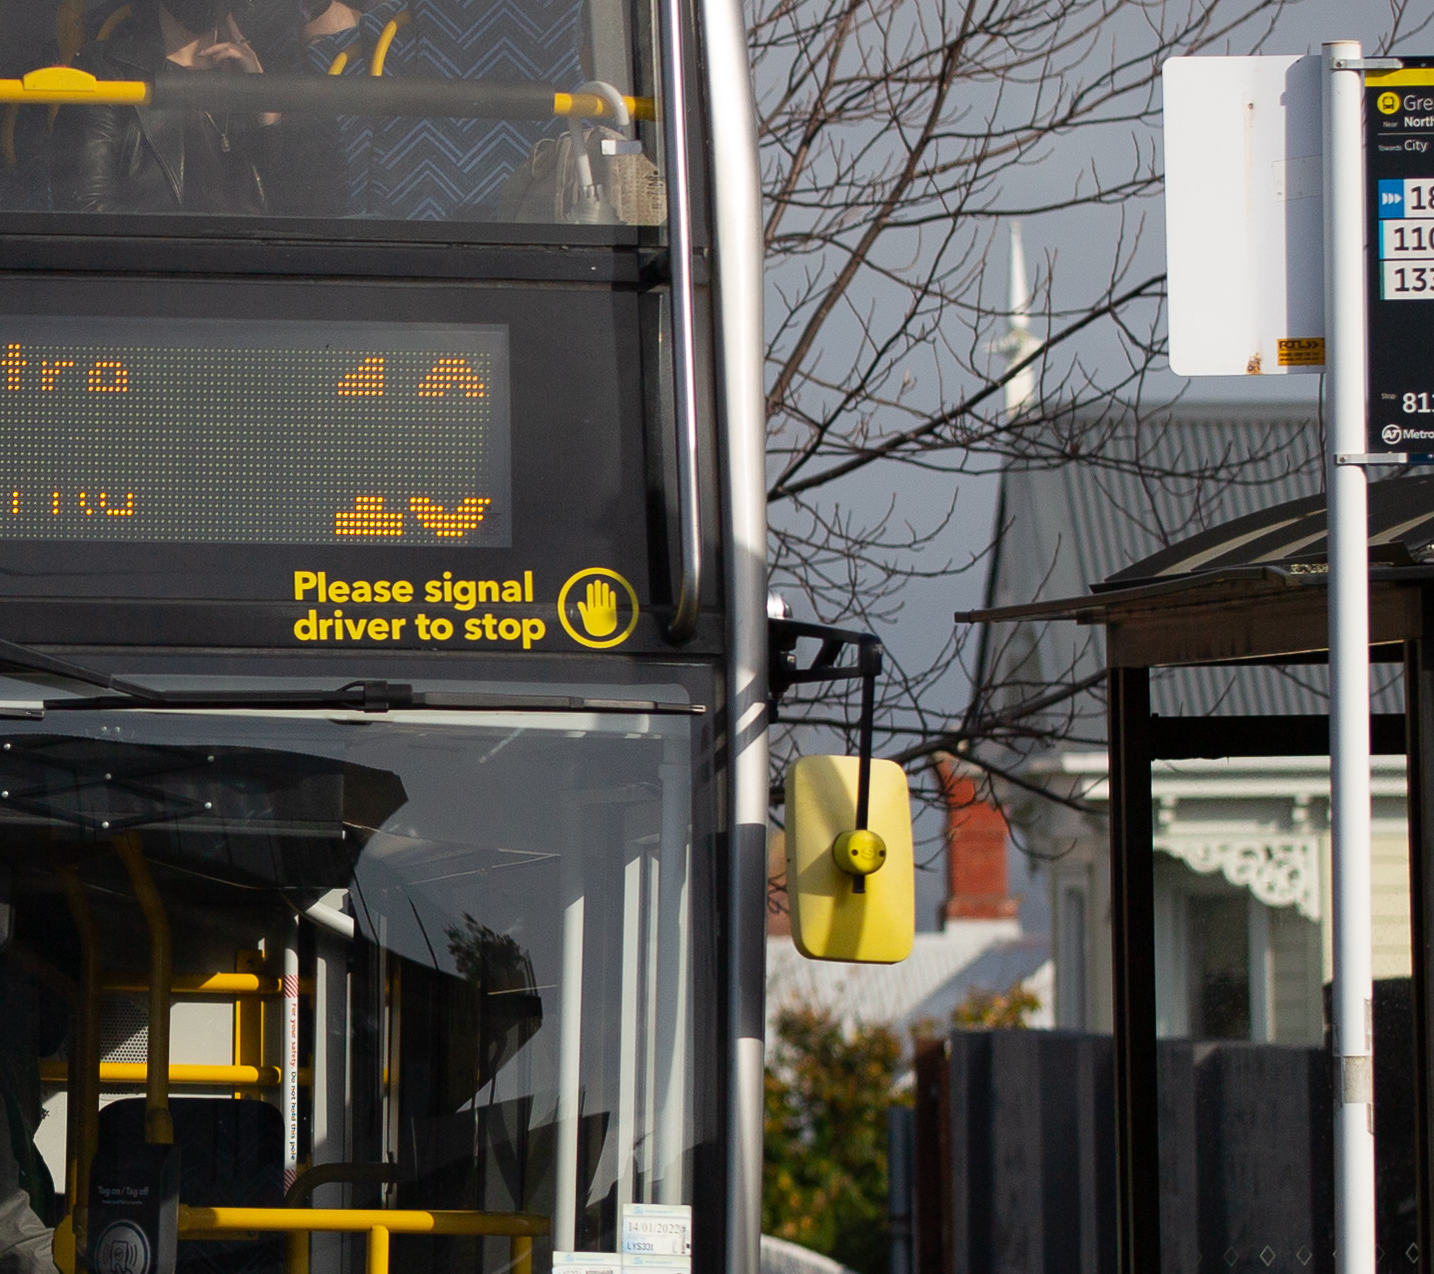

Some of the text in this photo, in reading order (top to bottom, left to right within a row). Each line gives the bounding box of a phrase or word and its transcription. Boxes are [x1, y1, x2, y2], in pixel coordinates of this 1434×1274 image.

[1404, 139, 1428, 153] City
[293, 570, 533, 611] Please signal
[293, 609, 547, 650] driver to stop
[291, 1071, 296, 1083] Do
[98, 1186, 111, 1197] Tag
[125, 1186, 138, 1198] Tag
[139, 1186, 150, 1195] off
